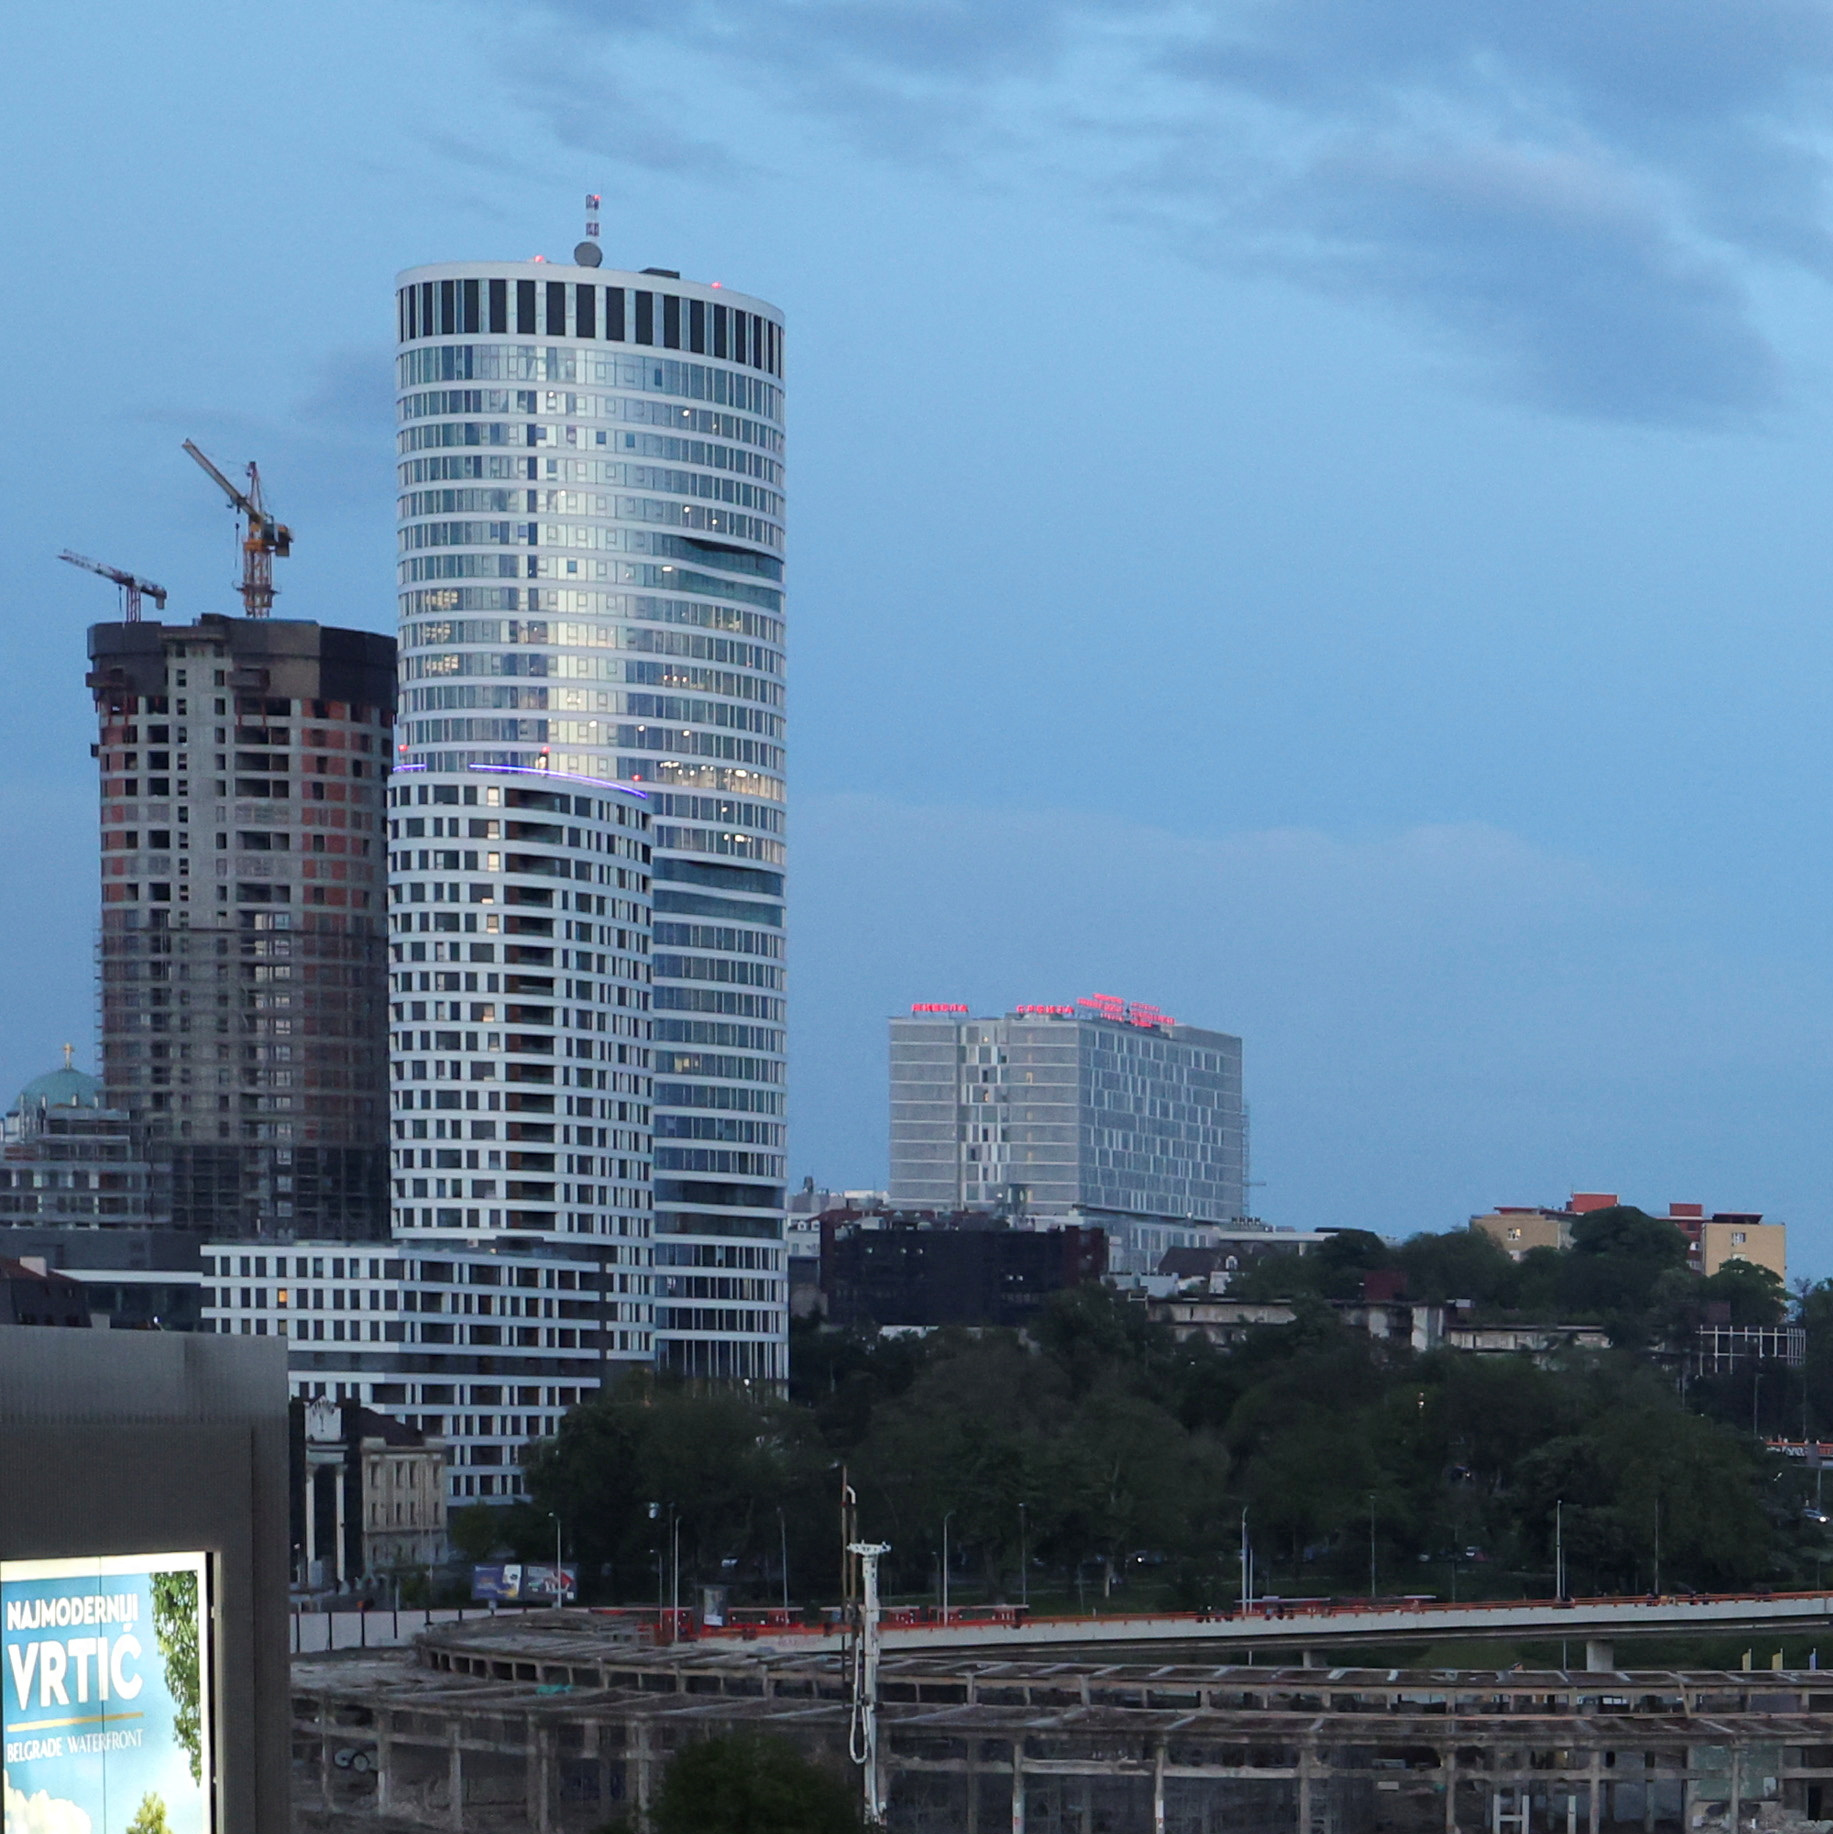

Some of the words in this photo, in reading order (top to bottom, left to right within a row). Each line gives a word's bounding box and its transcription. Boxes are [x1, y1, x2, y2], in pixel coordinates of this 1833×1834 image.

[7, 1622, 144, 1711] VRTIĆ
[7, 1737, 63, 1763] BELGRADE
[67, 1728, 144, 1754] WATERFRONT
